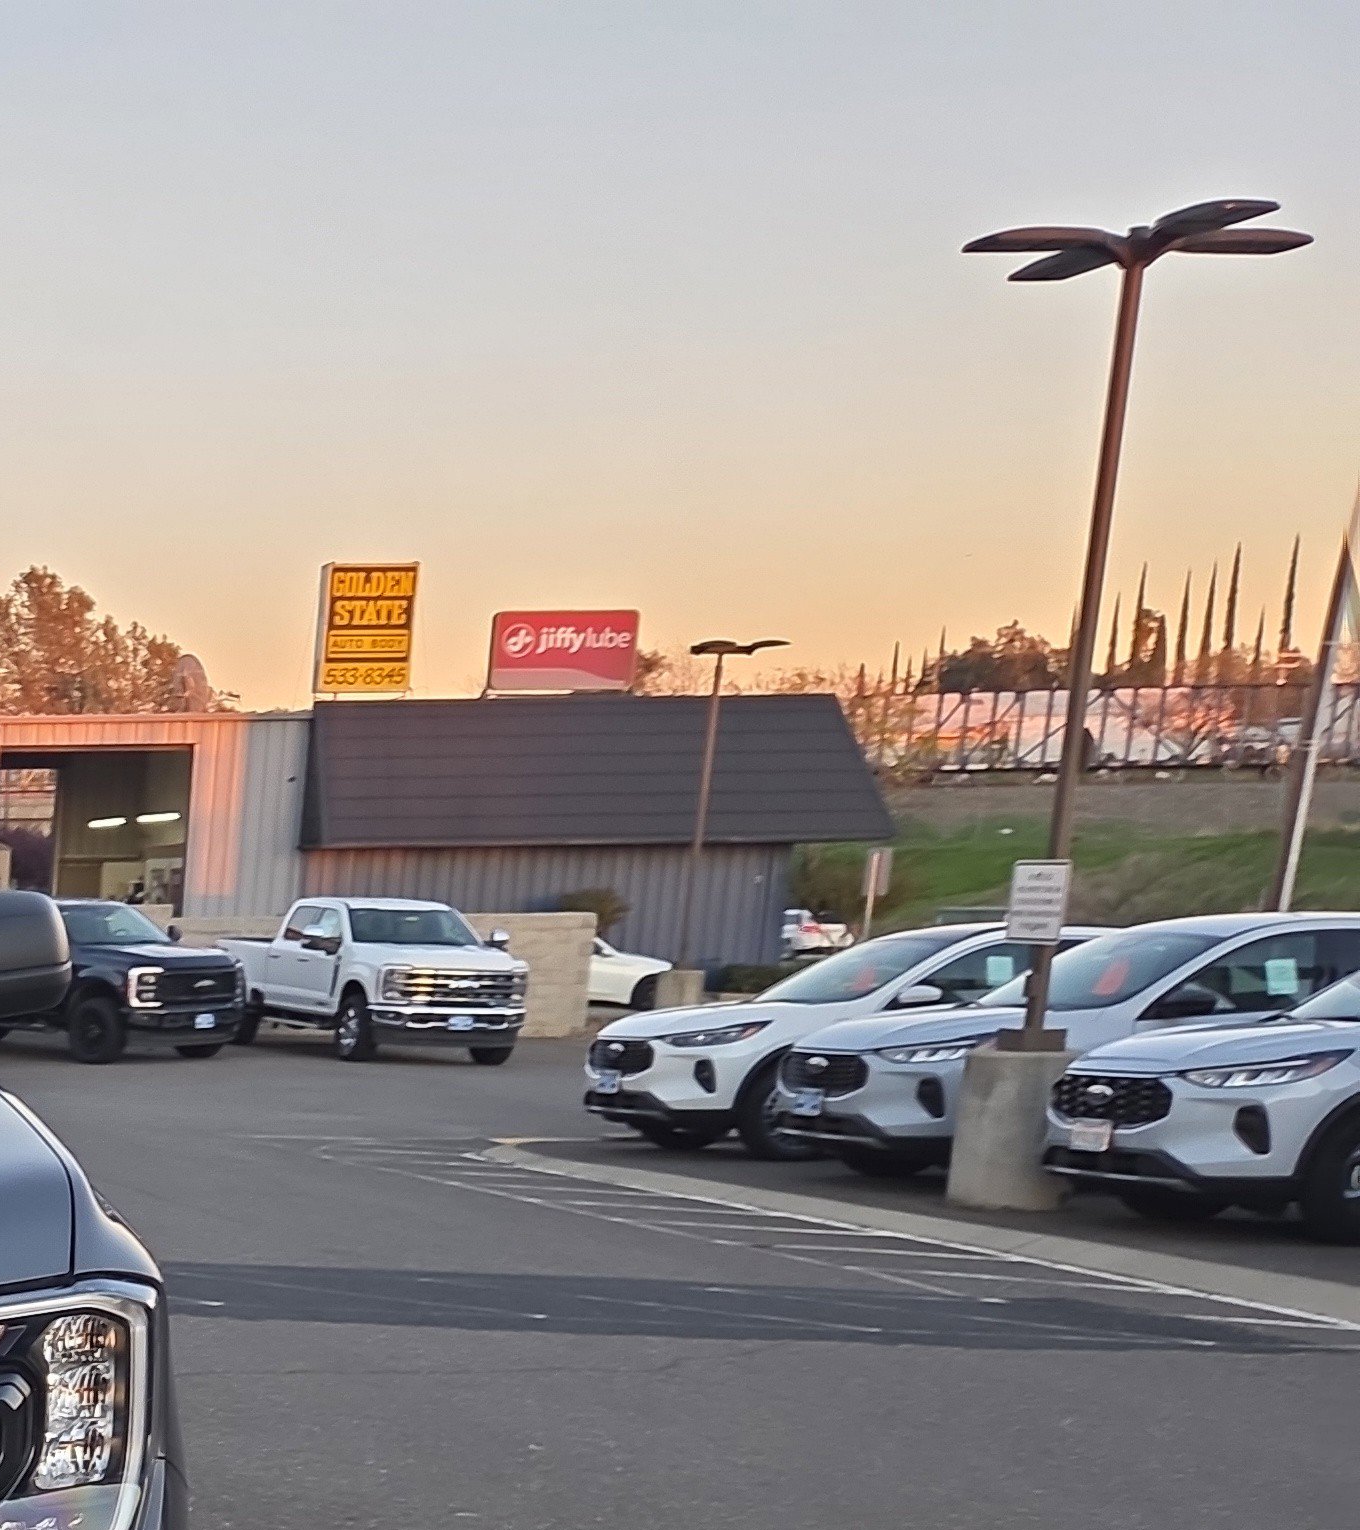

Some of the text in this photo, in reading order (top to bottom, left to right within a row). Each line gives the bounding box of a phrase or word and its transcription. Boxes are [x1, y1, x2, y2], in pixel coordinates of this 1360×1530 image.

[332, 571, 414, 597] GOLDEN
[333, 600, 408, 625] STATE
[331, 638, 404, 649] AUTO BODY
[323, 667, 406, 685] 533-8345
